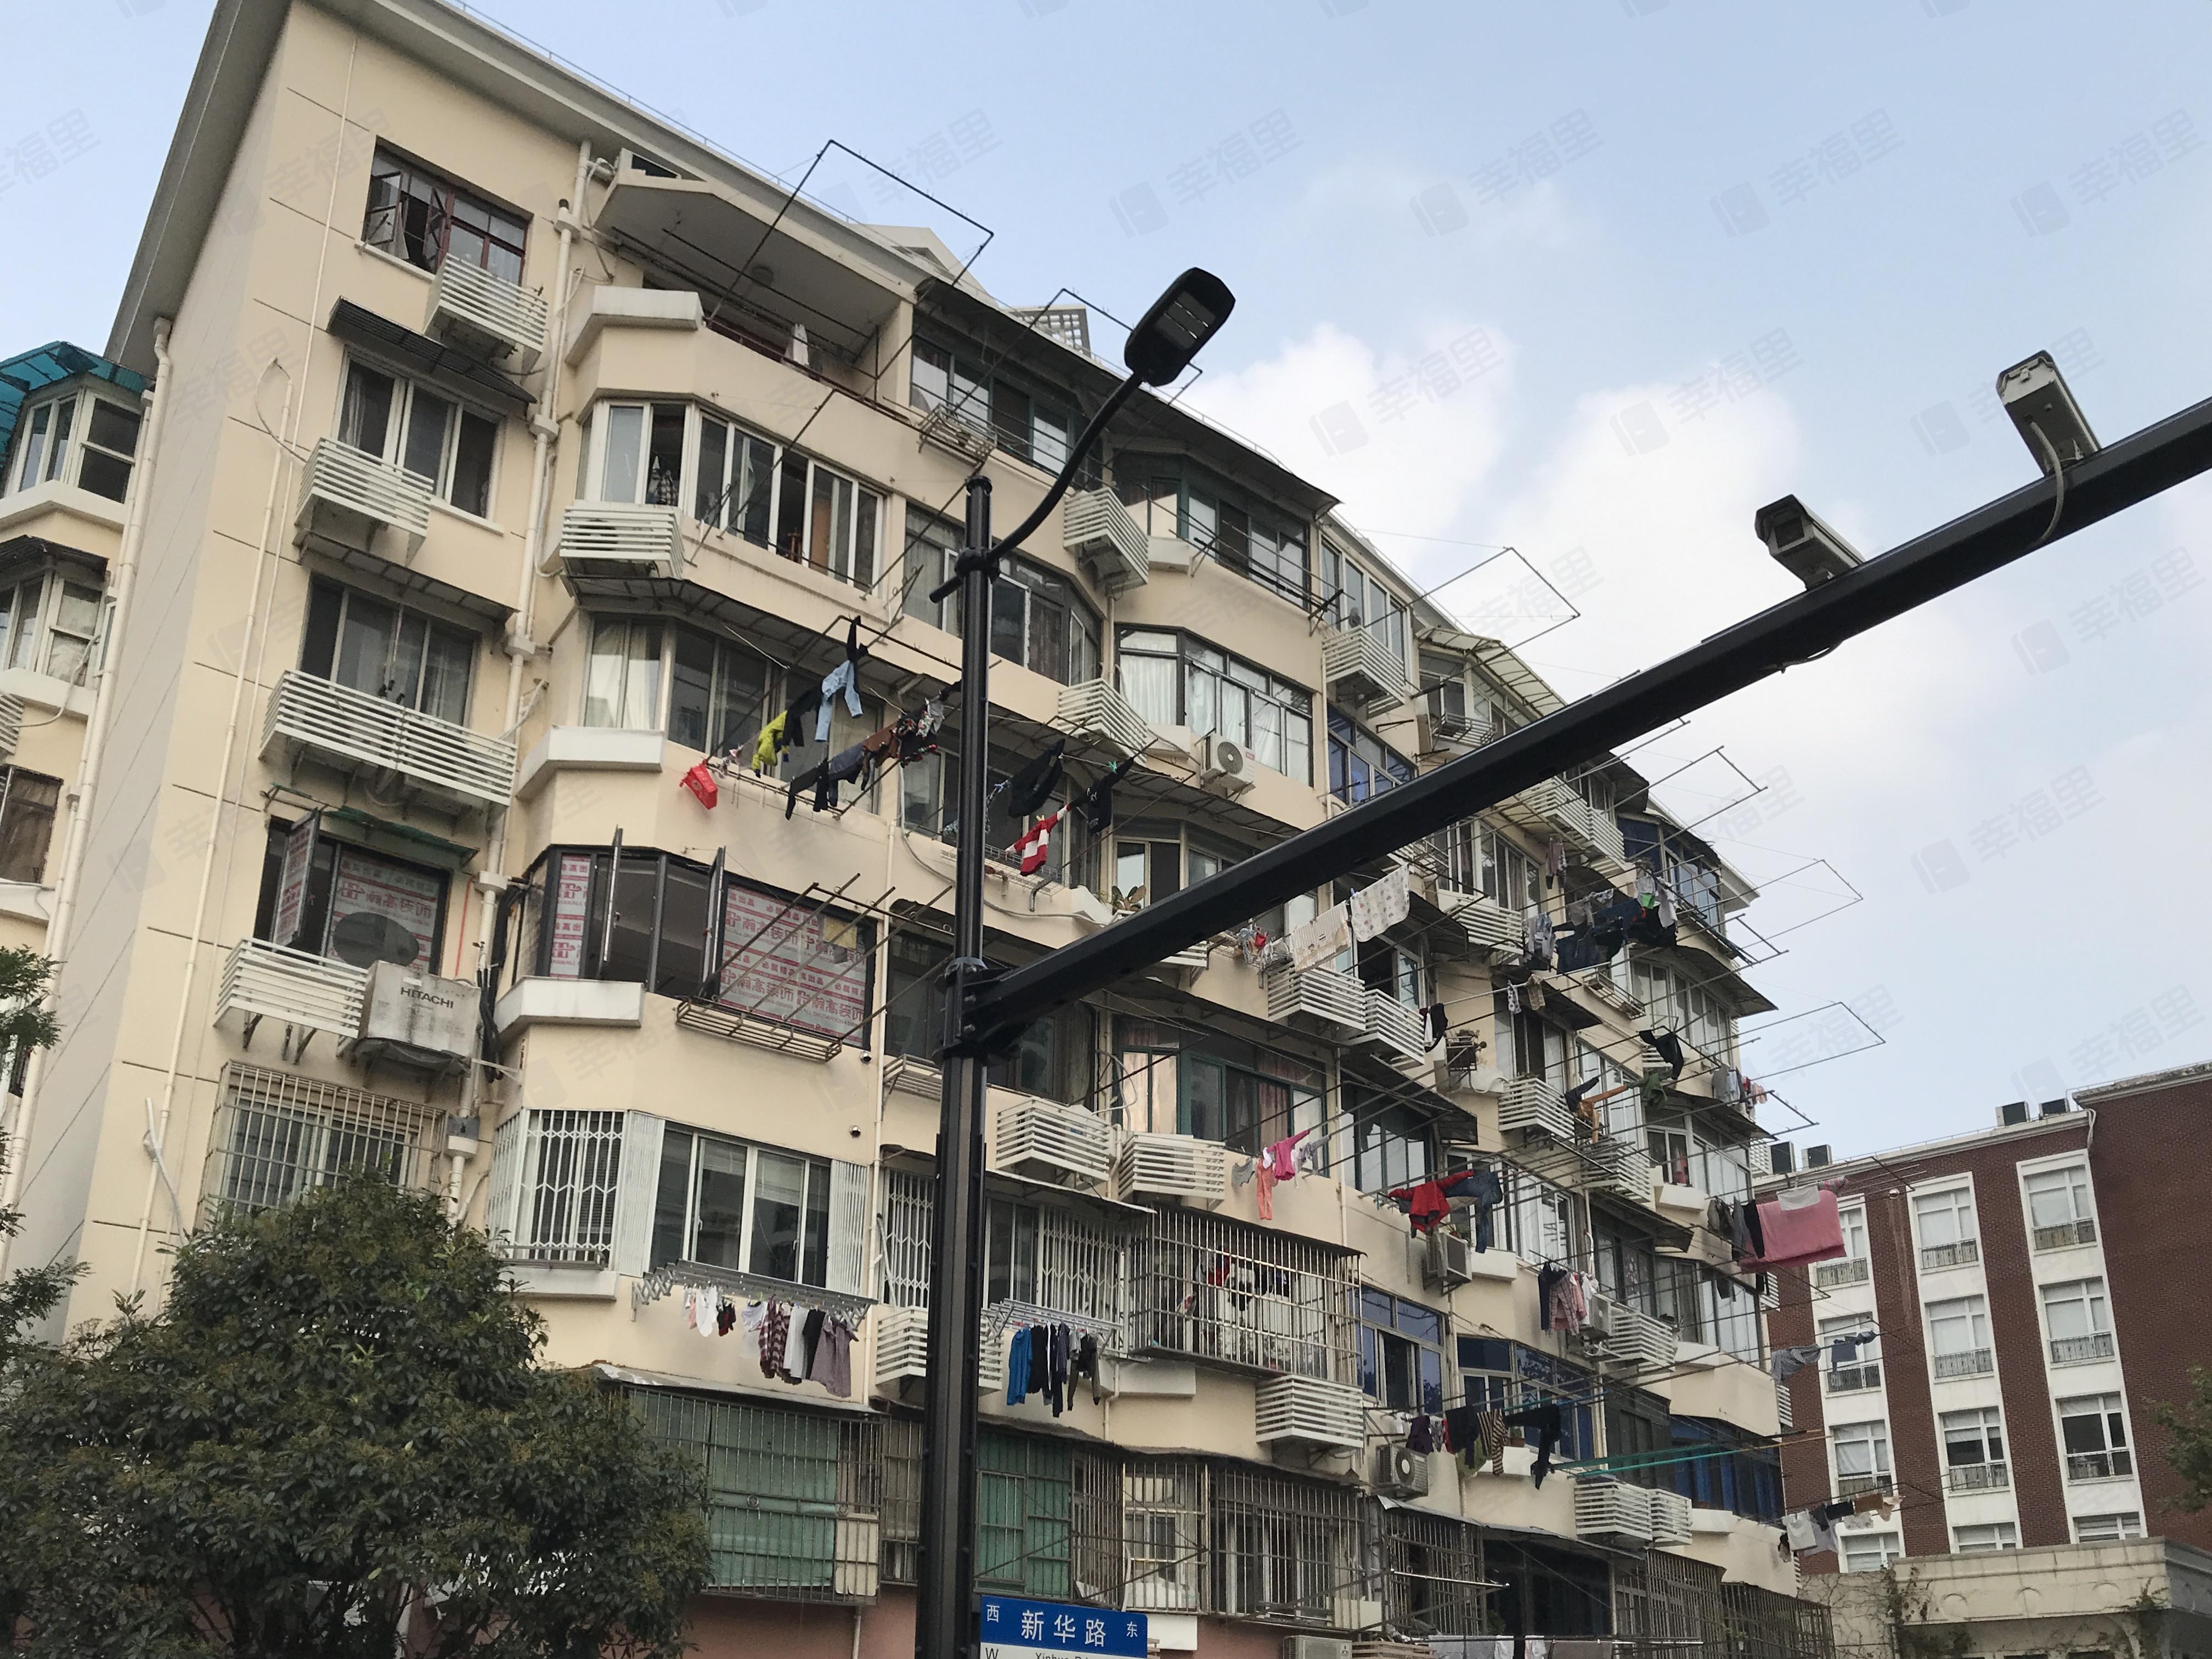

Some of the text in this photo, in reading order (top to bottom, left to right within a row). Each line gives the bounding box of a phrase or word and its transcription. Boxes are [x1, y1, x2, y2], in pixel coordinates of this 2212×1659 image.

[400, 987, 454, 1009] HITACHI
[986, 1604, 1138, 1647] 西 新华路 东
[985, 1647, 999, 1659] W
